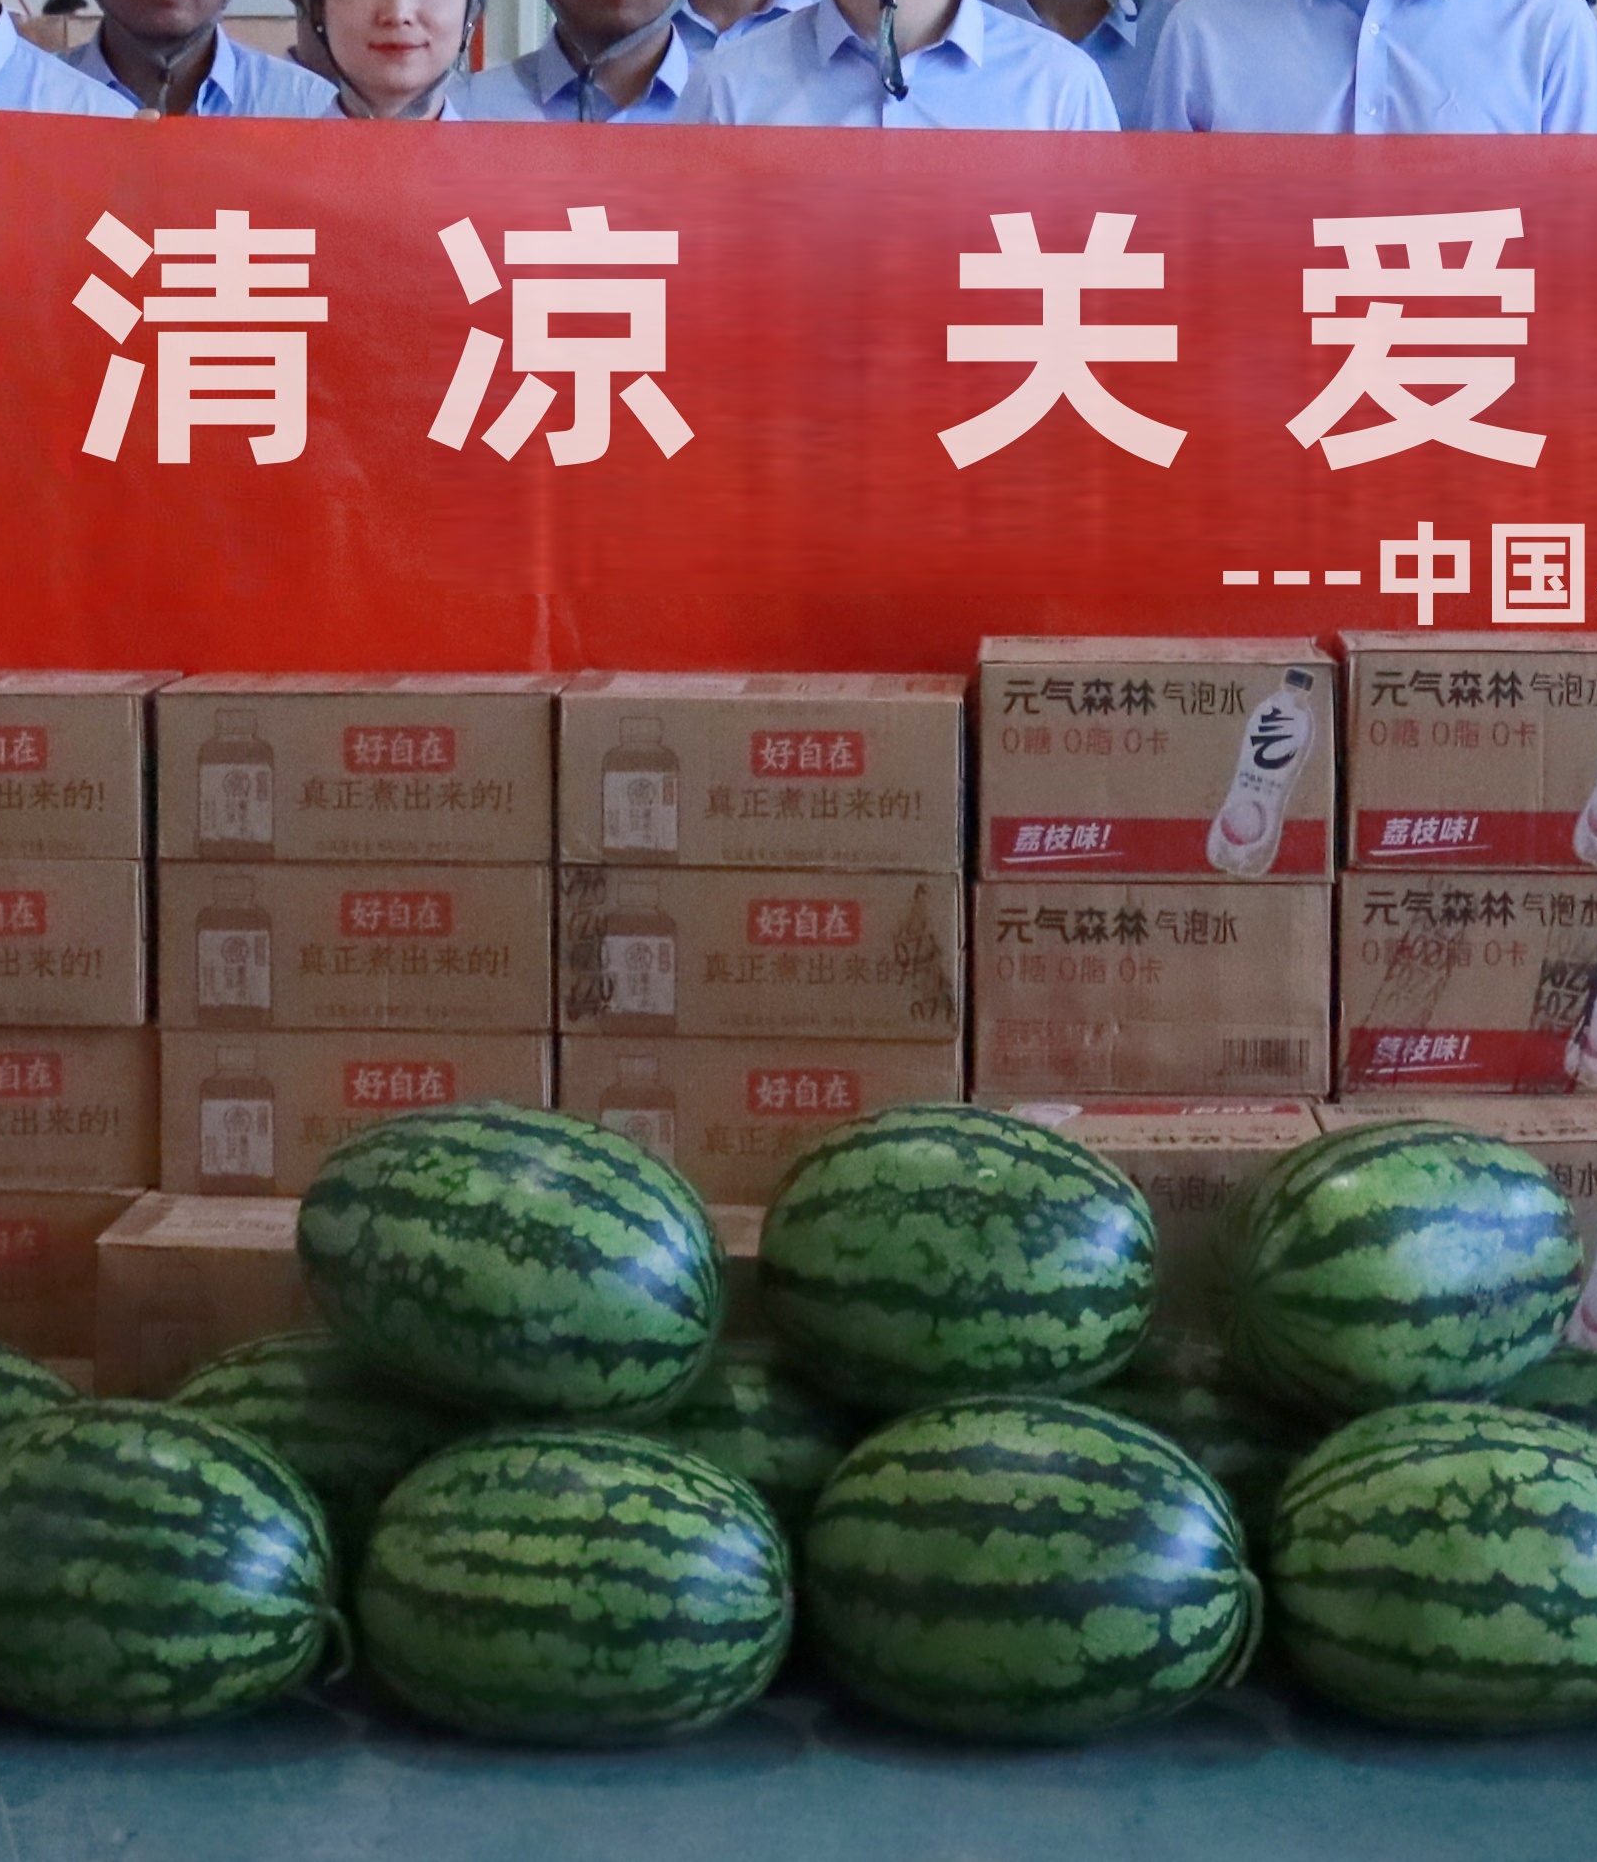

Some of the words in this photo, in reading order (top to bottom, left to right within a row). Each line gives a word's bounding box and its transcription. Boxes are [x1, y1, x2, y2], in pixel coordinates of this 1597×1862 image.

[352, 732, 447, 766] 好自在
[759, 739, 855, 771] 好自在
[349, 897, 443, 929] 好自在
[755, 906, 852, 938] 好自在
[352, 1067, 446, 1099] 好自在
[755, 1076, 852, 1107] 好自在
